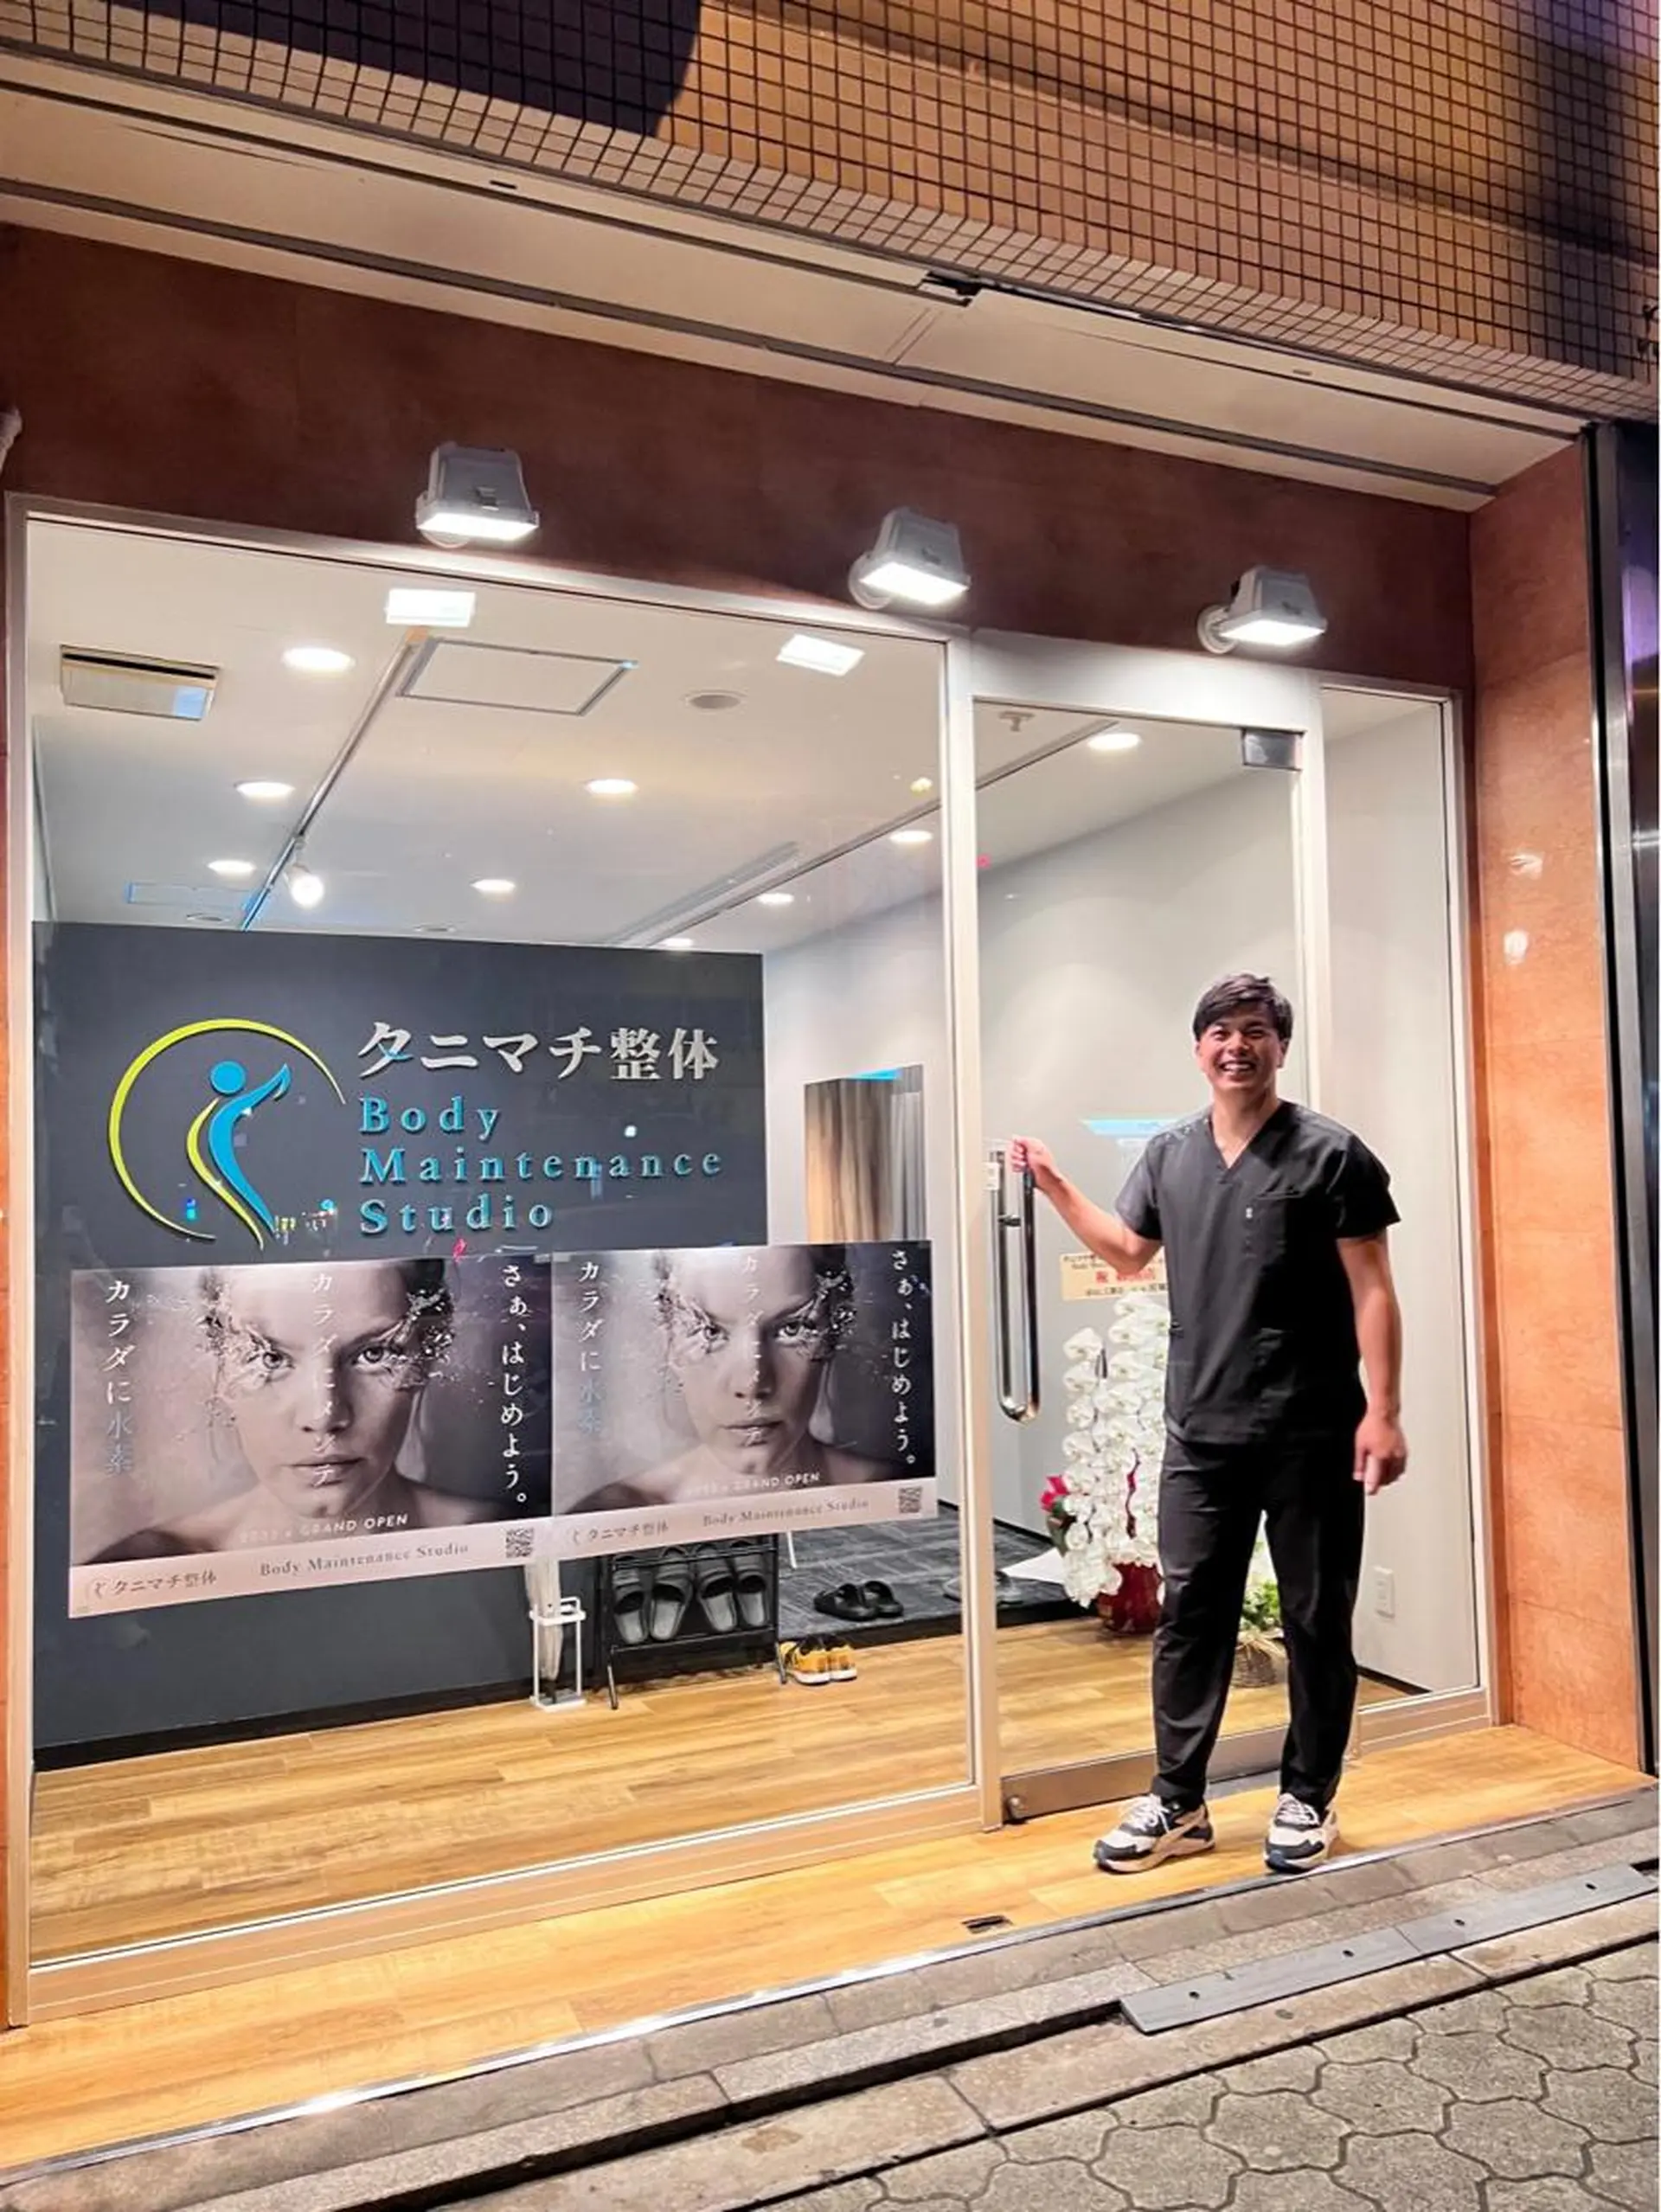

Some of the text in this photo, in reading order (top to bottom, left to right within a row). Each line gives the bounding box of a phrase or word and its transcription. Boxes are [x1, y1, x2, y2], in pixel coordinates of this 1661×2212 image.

[357, 1021, 720, 1080] タニマチ整体
[359, 1093, 499, 1140] Body
[359, 1147, 721, 1184] Maintenance
[359, 1193, 554, 1234] Studio
[785, 1472, 820, 1484] OPEN
[363, 1514, 408, 1529] OPEN
[702, 1515, 735, 1528] Body
[260, 1542, 469, 1578] Body Maintenance Studio
